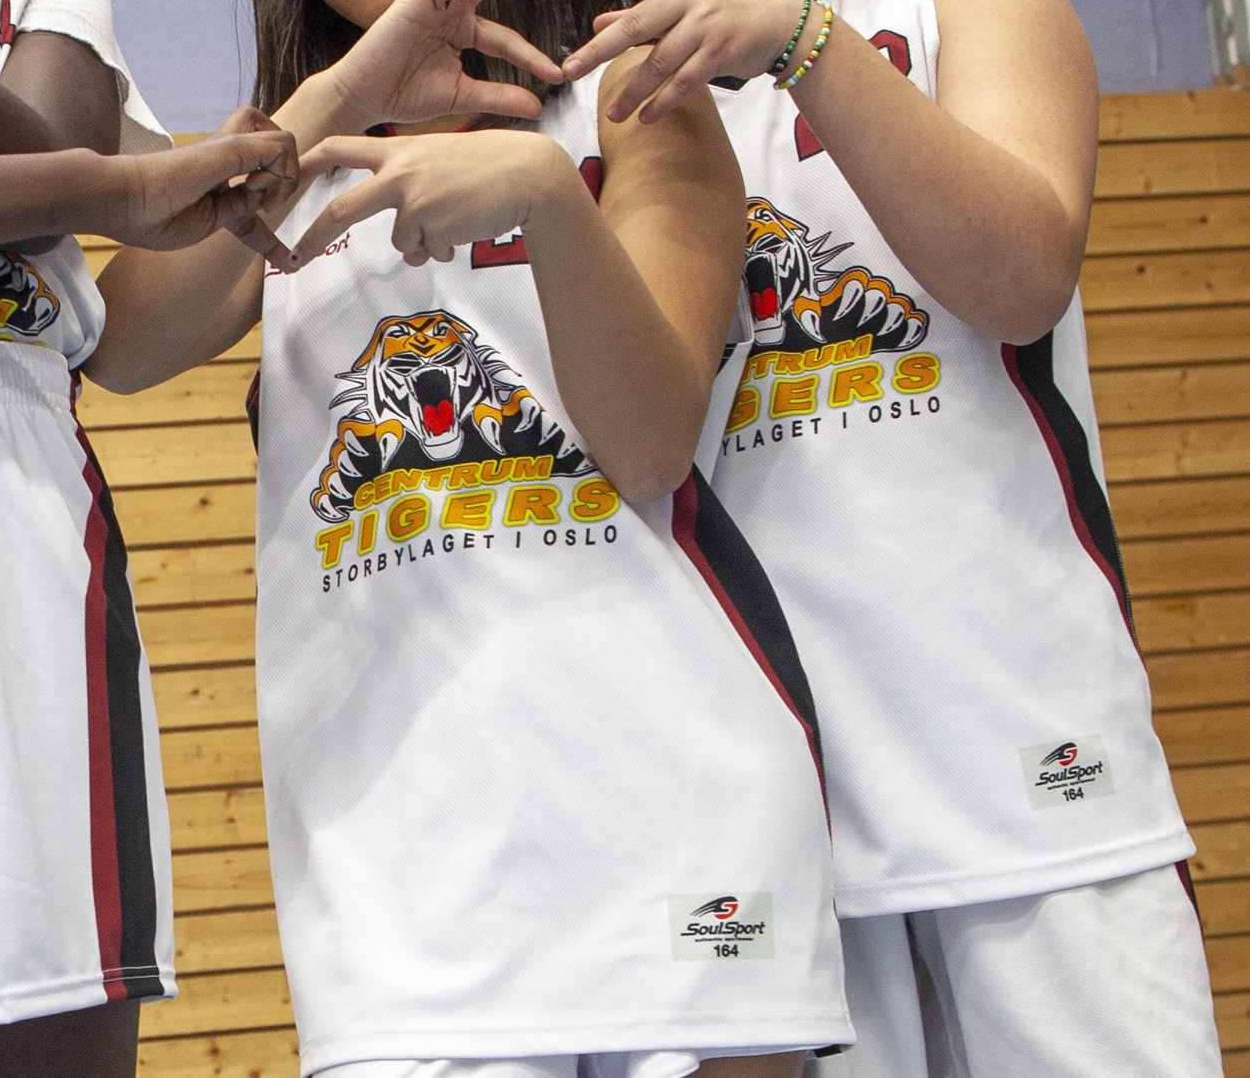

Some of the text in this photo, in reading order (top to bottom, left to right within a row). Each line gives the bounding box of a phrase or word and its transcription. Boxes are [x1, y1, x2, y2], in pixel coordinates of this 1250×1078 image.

[740, 333, 874, 385] TRUM
[725, 352, 941, 434] GERS
[722, 396, 941, 456] YLAGET I OSLO
[353, 454, 555, 510] CENTRUM
[315, 478, 622, 570] TIGERS
[322, 524, 618, 593] STORBYLAGET I OSLO
[1035, 760, 1103, 787] SoulSport
[1062, 786, 1084, 802] 164
[680, 921, 766, 938] SoulSport
[713, 943, 739, 958] 164
